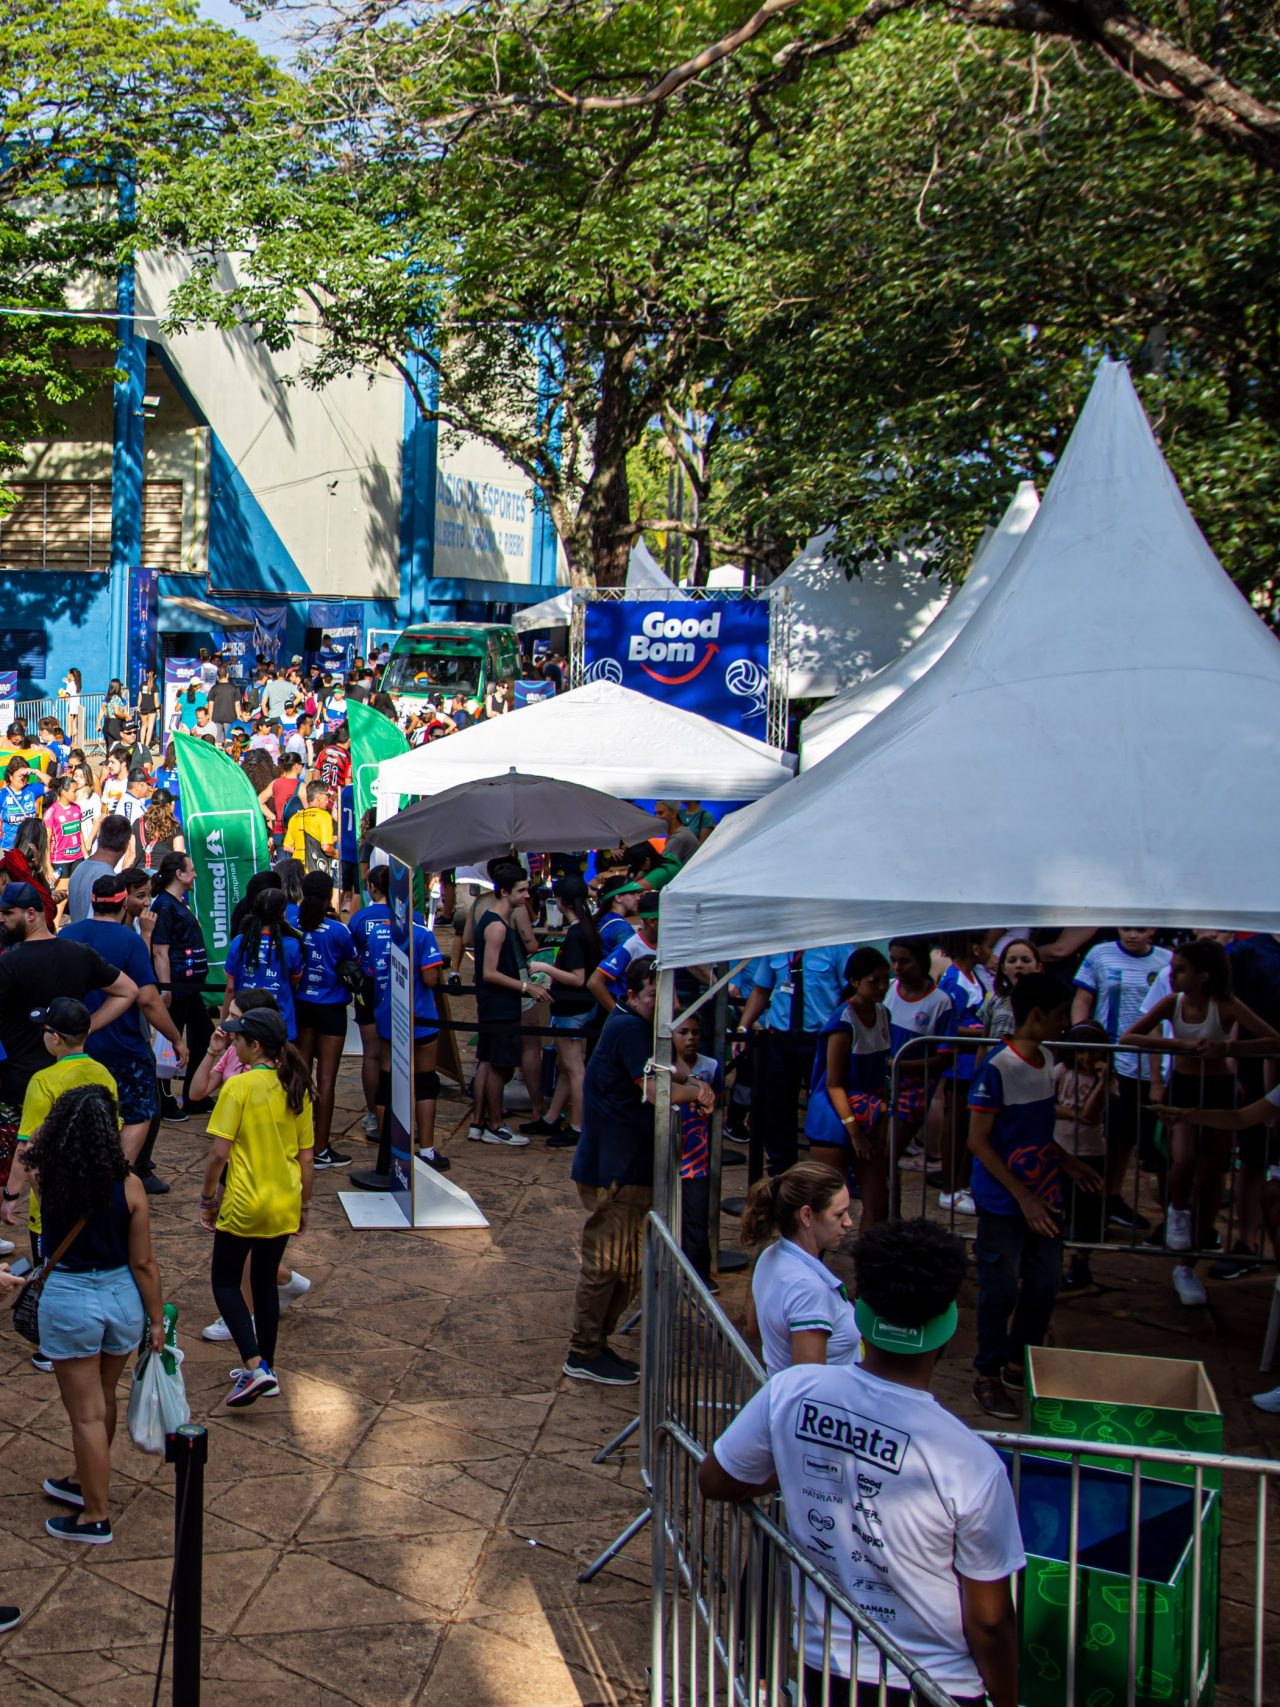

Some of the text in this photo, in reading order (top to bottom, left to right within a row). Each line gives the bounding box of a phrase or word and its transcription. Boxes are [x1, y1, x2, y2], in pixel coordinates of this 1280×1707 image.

[482, 484, 526, 523] ESPORTES
[642, 611, 721, 638] Good
[628, 635, 696, 662] Bom
[321, 763, 338, 786] 21
[229, 862, 240, 904] Campinas
[207, 862, 228, 949] Unimed
[800, 1403, 897, 1466] Renata
[857, 1473, 882, 1490] Good
[858, 1482, 873, 1493] om
[802, 1487, 843, 1505] PATRIANI
